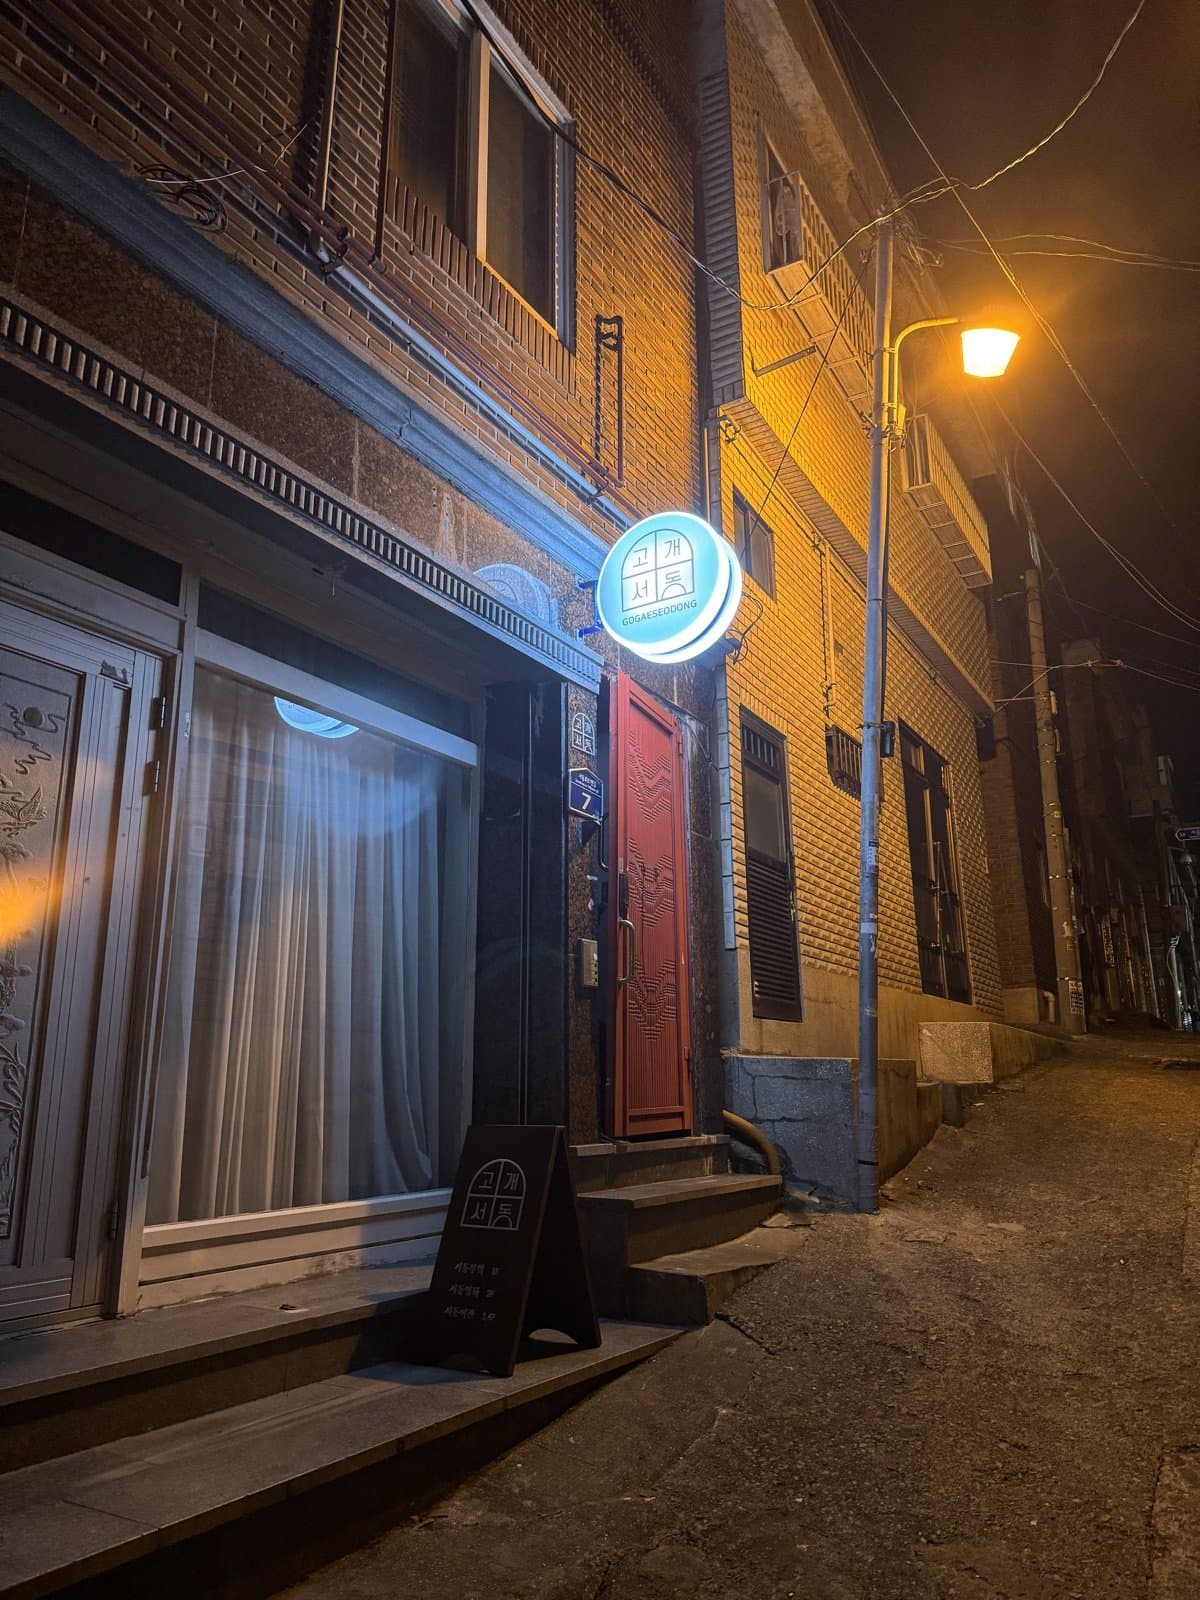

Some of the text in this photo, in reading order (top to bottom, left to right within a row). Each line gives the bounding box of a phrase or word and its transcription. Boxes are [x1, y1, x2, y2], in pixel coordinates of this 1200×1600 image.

[632, 537, 681, 568] 고개
[622, 599, 698, 626] GOGAESEODONG
[581, 792, 591, 810] 7
[478, 1171, 520, 1191] 고개
